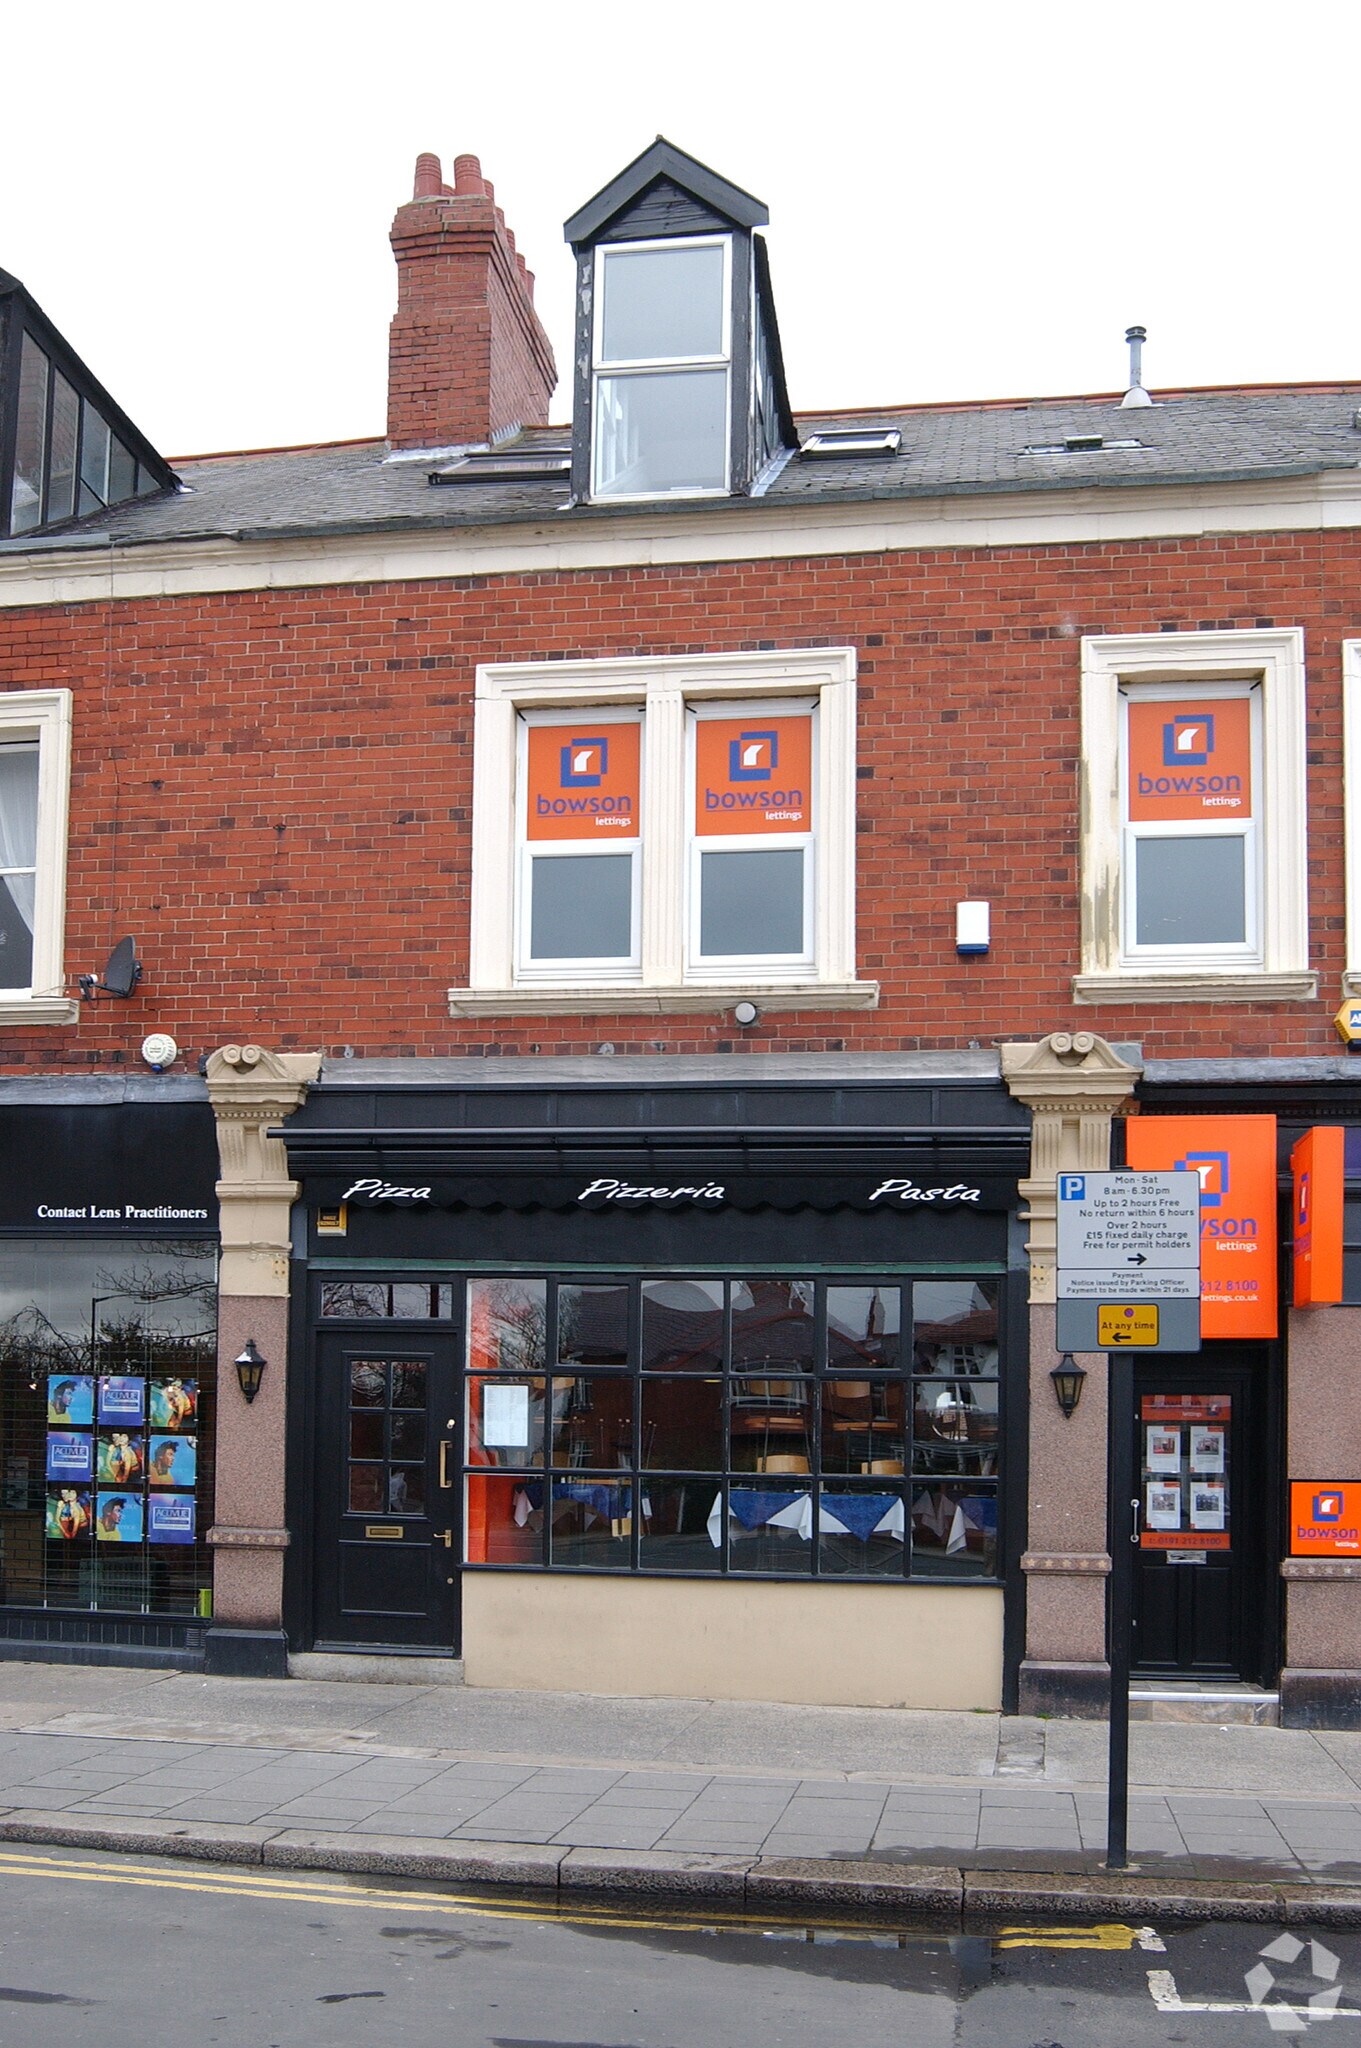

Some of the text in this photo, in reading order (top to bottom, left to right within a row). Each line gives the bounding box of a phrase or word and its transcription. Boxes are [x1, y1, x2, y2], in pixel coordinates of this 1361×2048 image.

[1138, 773, 1240, 794] bowson
[705, 788, 802, 809] bowson
[1203, 797, 1241, 806] lettings
[537, 794, 631, 814] bowson
[595, 816, 631, 826] lettings
[766, 811, 802, 821] lettings
[342, 1178, 980, 1202] Pizza Pizzeria Pasta
[1065, 1178, 1082, 1199] P
[1094, 1199, 1107, 1209] Up
[1121, 1199, 1127, 1207] 2
[1130, 1199, 1157, 1207] hours
[1159, 1199, 1179, 1207] Free
[38, 1204, 208, 1219] Contact Lens Practitioners
[1079, 1209, 1093, 1217] No
[1128, 1209, 1157, 1217] within
[1140, 1221, 1167, 1229] hours
[1105, 1231, 1128, 1239] fixed
[1131, 1231, 1153, 1241] daily
[1156, 1231, 1188, 1241] charge
[1083, 1241, 1104, 1249] Free
[1106, 1241, 1120, 1249] for
[1122, 1241, 1153, 1250] permit
[1216, 1241, 1258, 1252] lettings
[1120, 1279, 1128, 1287] by
[1130, 1279, 1158, 1287] Parking
[1226, 1280, 1258, 1291] 8100
[1201, 1294, 1258, 1302] lettings.co.uk
[1297, 1525, 1358, 1539] bowson
[1183, 1537, 1197, 1545] 212
